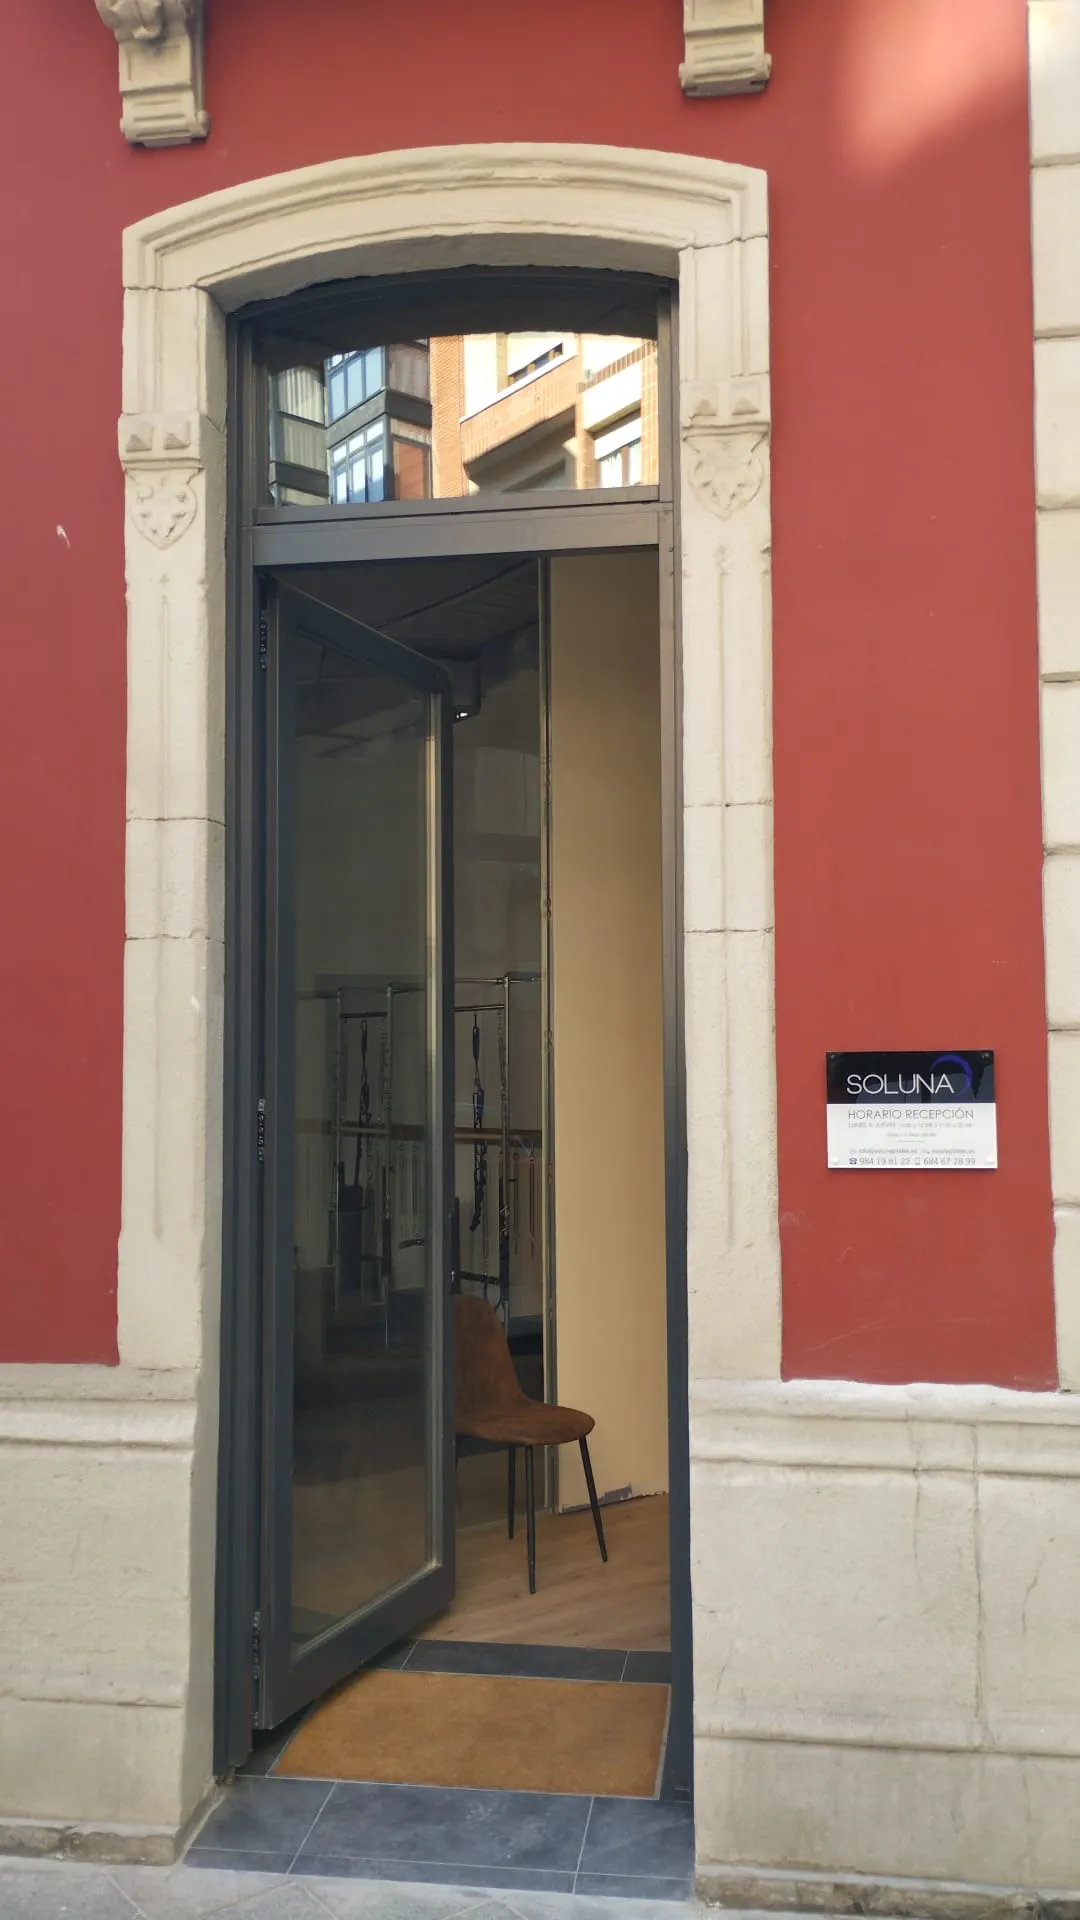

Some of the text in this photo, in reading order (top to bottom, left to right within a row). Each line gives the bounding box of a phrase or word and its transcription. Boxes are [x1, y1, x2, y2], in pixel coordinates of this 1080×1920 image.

[846, 1073, 955, 1095] SOLUNA
[848, 1107, 974, 1120] HORARIO RECEPCIÓN
[859, 1157, 976, 1166] 984 19 81 22 684 67 28 99
